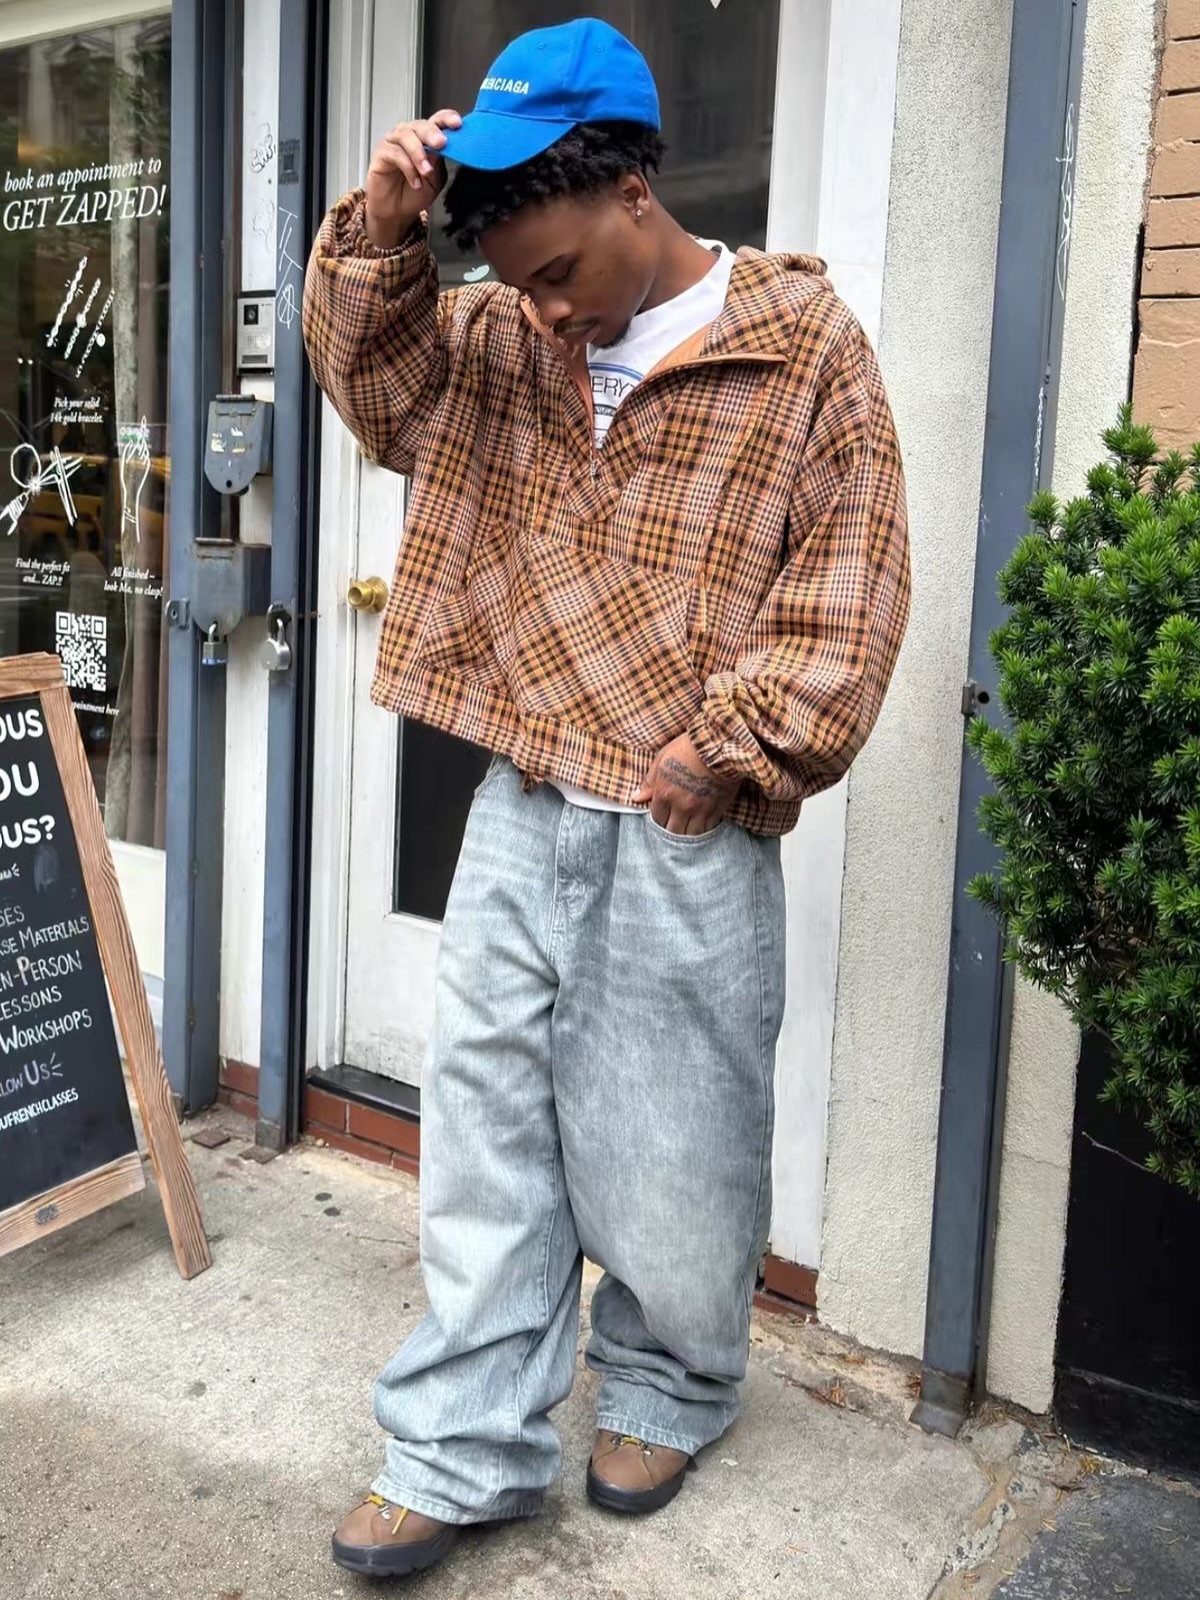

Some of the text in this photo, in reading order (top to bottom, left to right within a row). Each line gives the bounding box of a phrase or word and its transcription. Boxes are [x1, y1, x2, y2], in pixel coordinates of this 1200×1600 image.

[4, 157, 162, 193] book an appointment to
[3, 184, 167, 232] GET ZAPPED!
[53, 396, 69, 408] Pick
[68, 400, 84, 411] your
[62, 411, 78, 426] gold
[15, 557, 31, 569] Find
[30, 558, 41, 570] the
[40, 560, 62, 574] perfect
[110, 566, 123, 577] All
[121, 566, 150, 581] finished
[103, 580, 119, 592] look
[134, 586, 144, 595] no
[143, 583, 164, 600] clasp!
[105, 703, 120, 717] here
[0, 814, 56, 850] US?
[0, 1008, 93, 1055] WORKSHOPS
